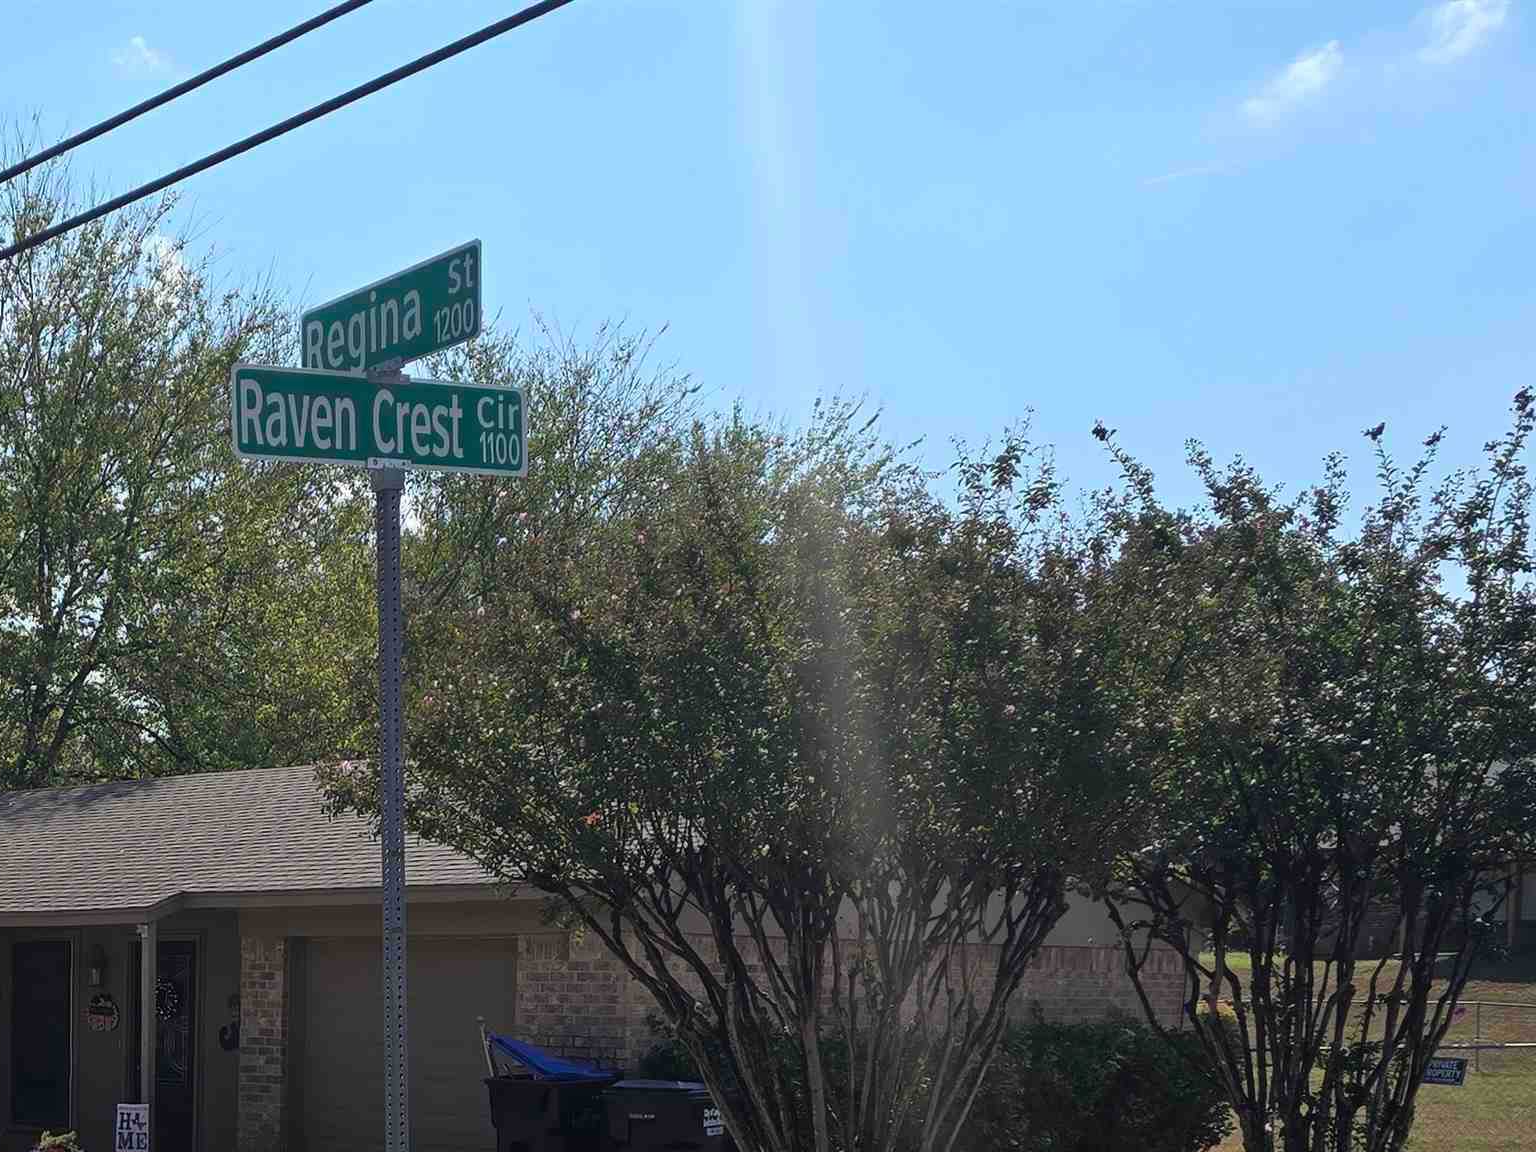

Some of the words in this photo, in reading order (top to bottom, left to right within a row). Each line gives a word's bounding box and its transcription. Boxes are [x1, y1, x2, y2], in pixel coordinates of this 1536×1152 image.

[306, 290, 422, 371] Regina
[448, 253, 474, 295] St
[433, 299, 474, 344] 1200
[239, 378, 357, 451] Raven
[372, 388, 464, 458] Crest
[476, 394, 519, 430] Cir
[479, 432, 519, 465] 1100
[1426, 1069, 1462, 1079] ROPERTY
